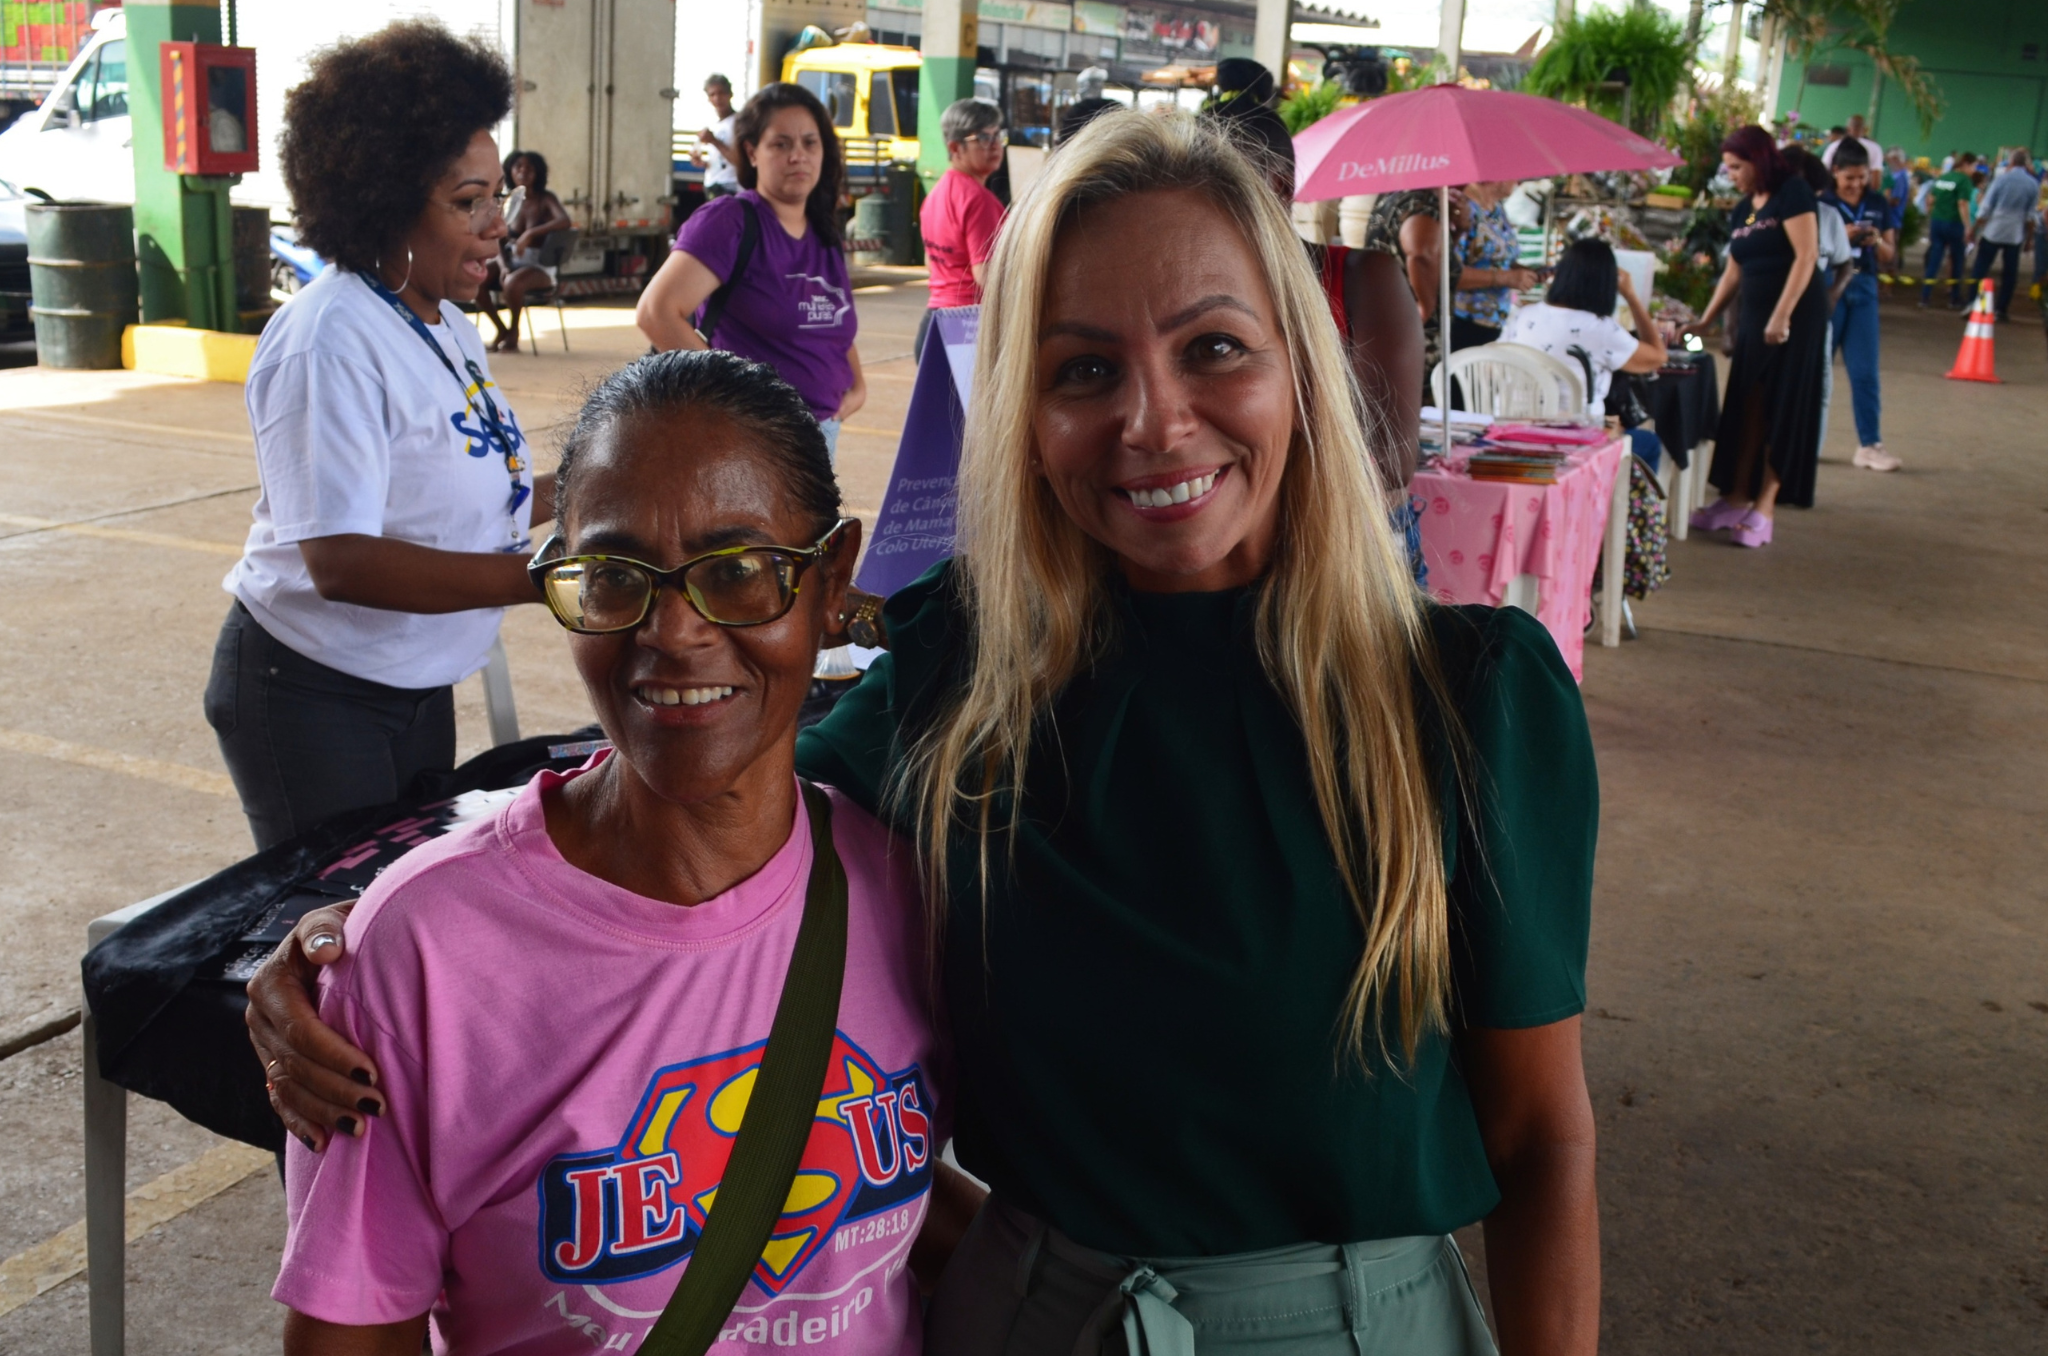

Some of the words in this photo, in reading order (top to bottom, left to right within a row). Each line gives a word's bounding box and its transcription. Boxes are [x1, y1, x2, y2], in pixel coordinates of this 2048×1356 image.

[1338, 153, 1450, 181] DeMillus
[889, 498, 910, 515] de
[883, 519, 903, 536] de
[904, 516, 953, 533] Mama
[876, 540, 909, 556] Colo
[834, 1208, 910, 1254] MT:28:18
[544, 1290, 633, 1352] Meu
